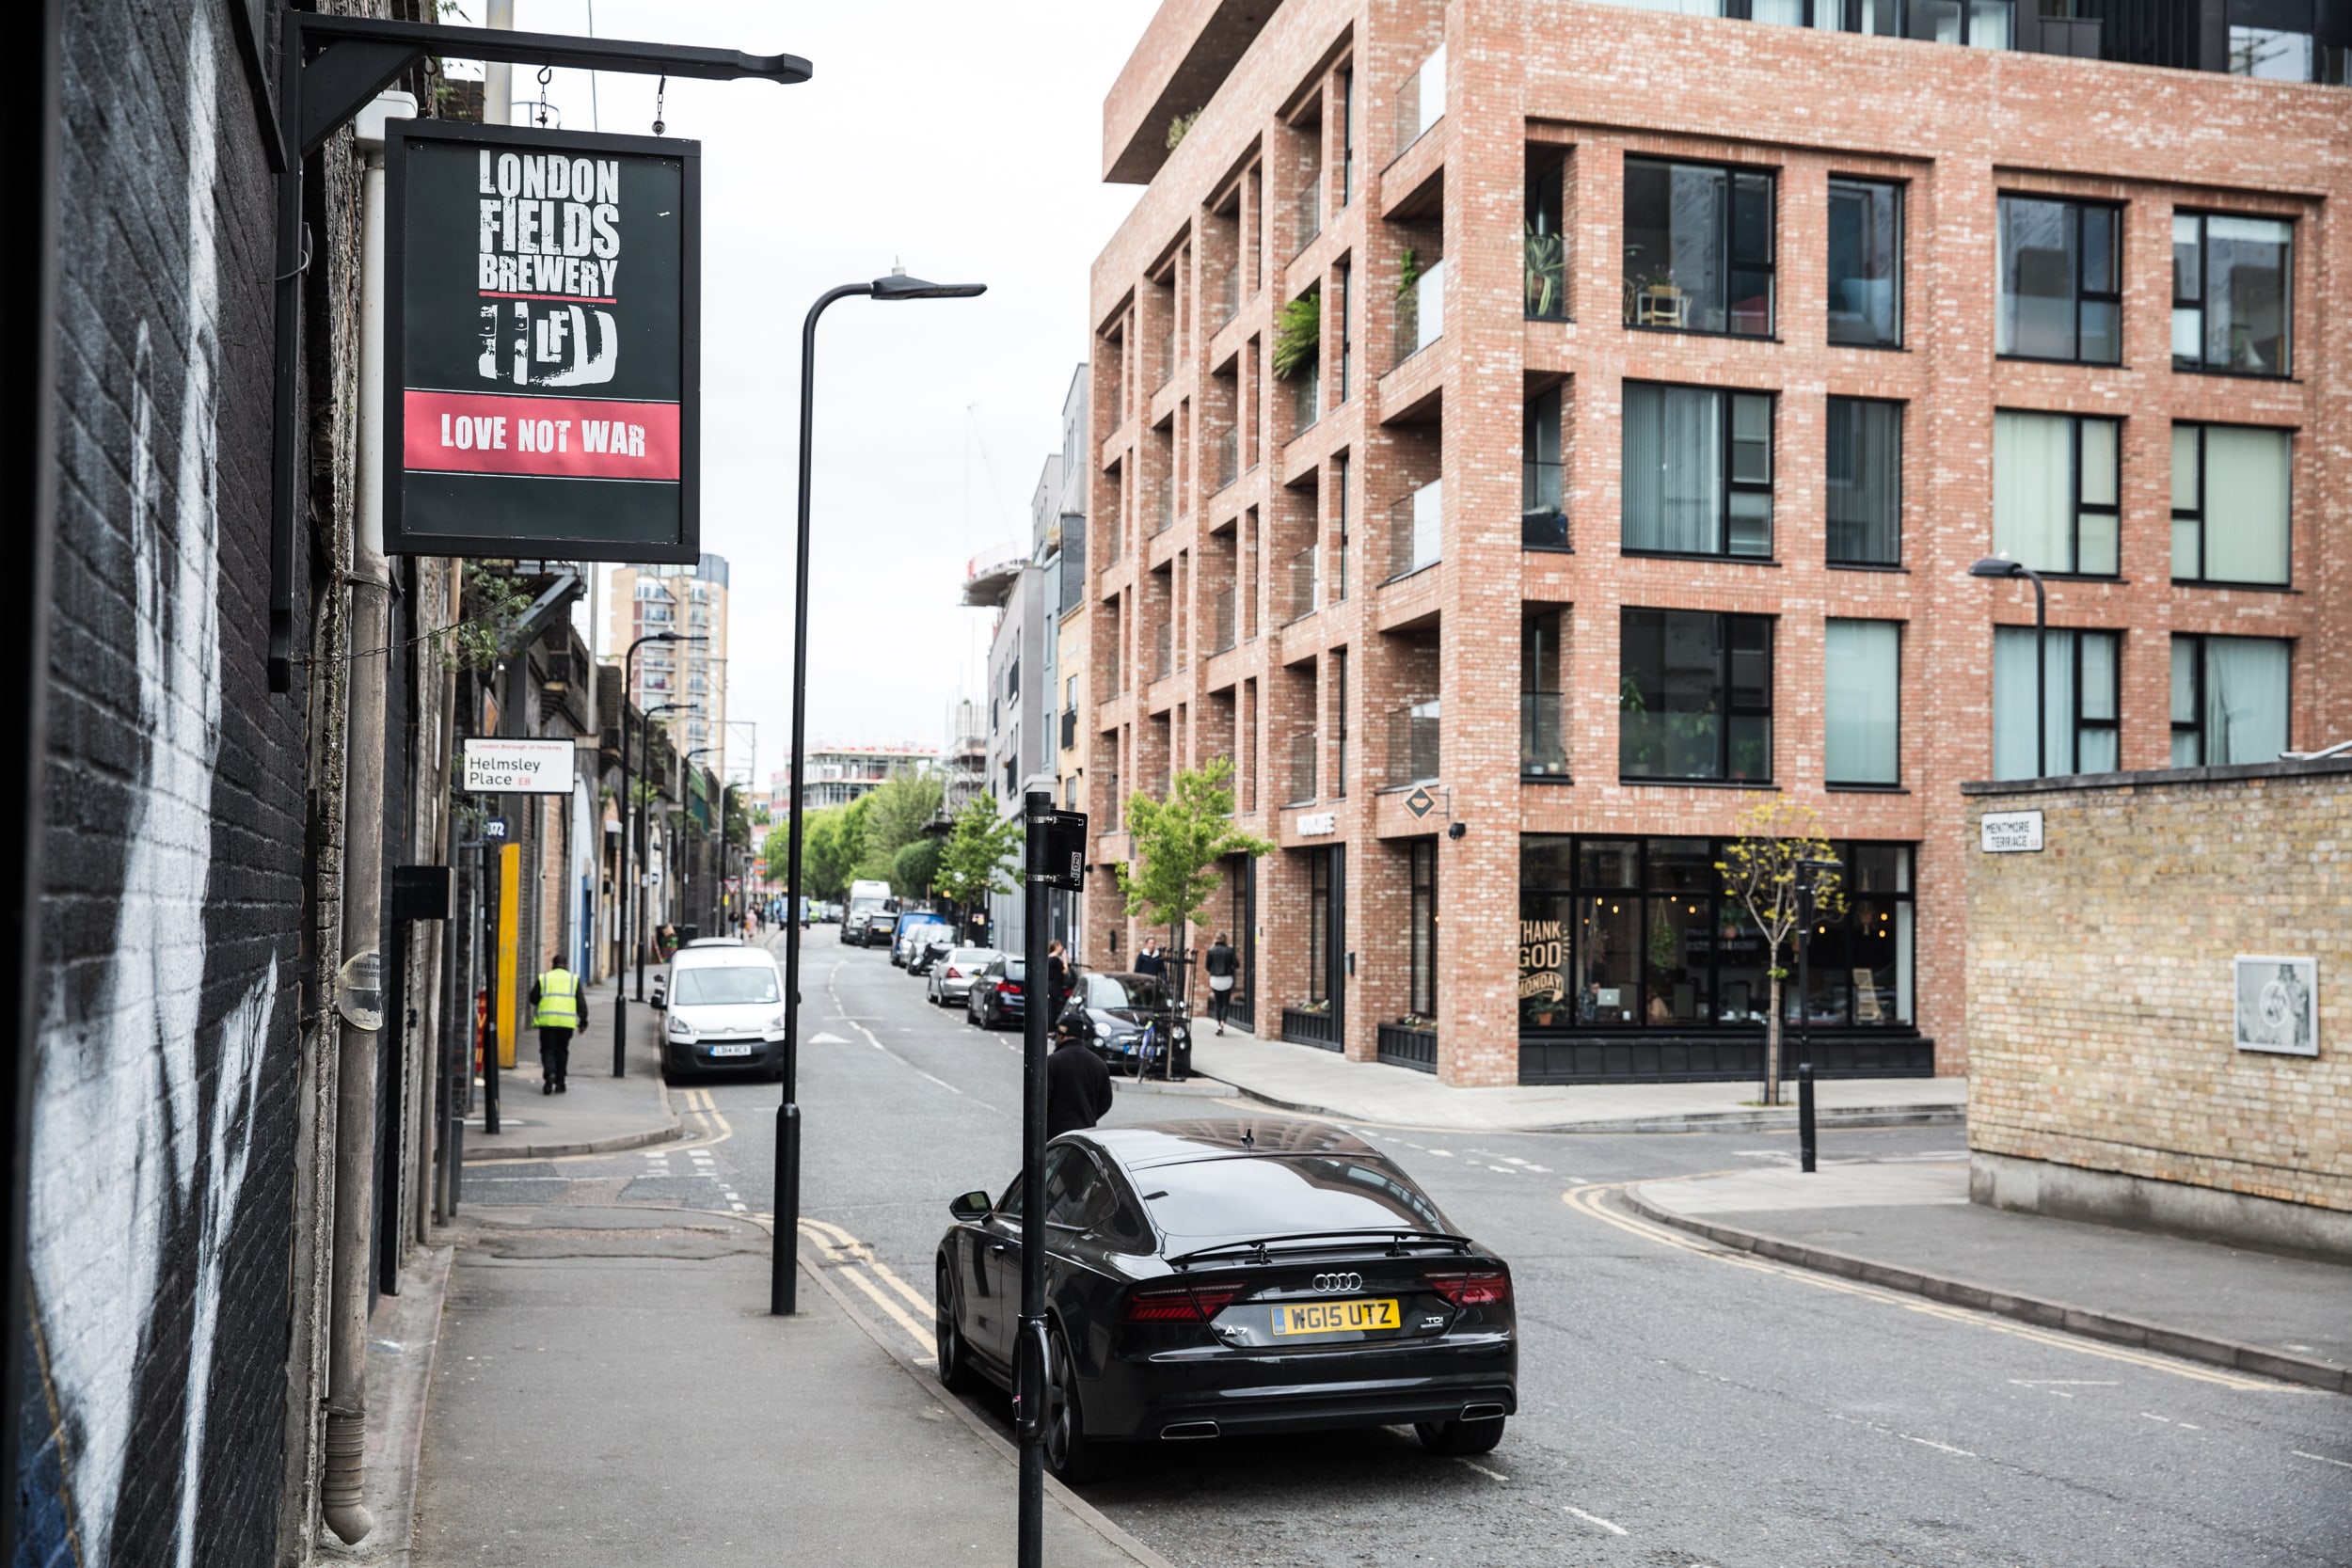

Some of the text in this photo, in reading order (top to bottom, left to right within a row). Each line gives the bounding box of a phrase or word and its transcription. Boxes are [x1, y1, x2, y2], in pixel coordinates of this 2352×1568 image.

[479, 150, 619, 204] LONDON
[479, 198, 620, 258] FIELDS
[479, 253, 618, 297] BREWERY
[441, 413, 645, 458] LOVE NOT WAR
[469, 757, 541, 773] Helmsley
[470, 772, 512, 785] Place
[1991, 835, 2027, 847] TERRACE
[1519, 942, 1562, 969] GOD
[1292, 1303, 1392, 1329] WG15 UTZ
[1425, 1316, 1444, 1324] TDI
[1224, 1324, 1248, 1336] A7
